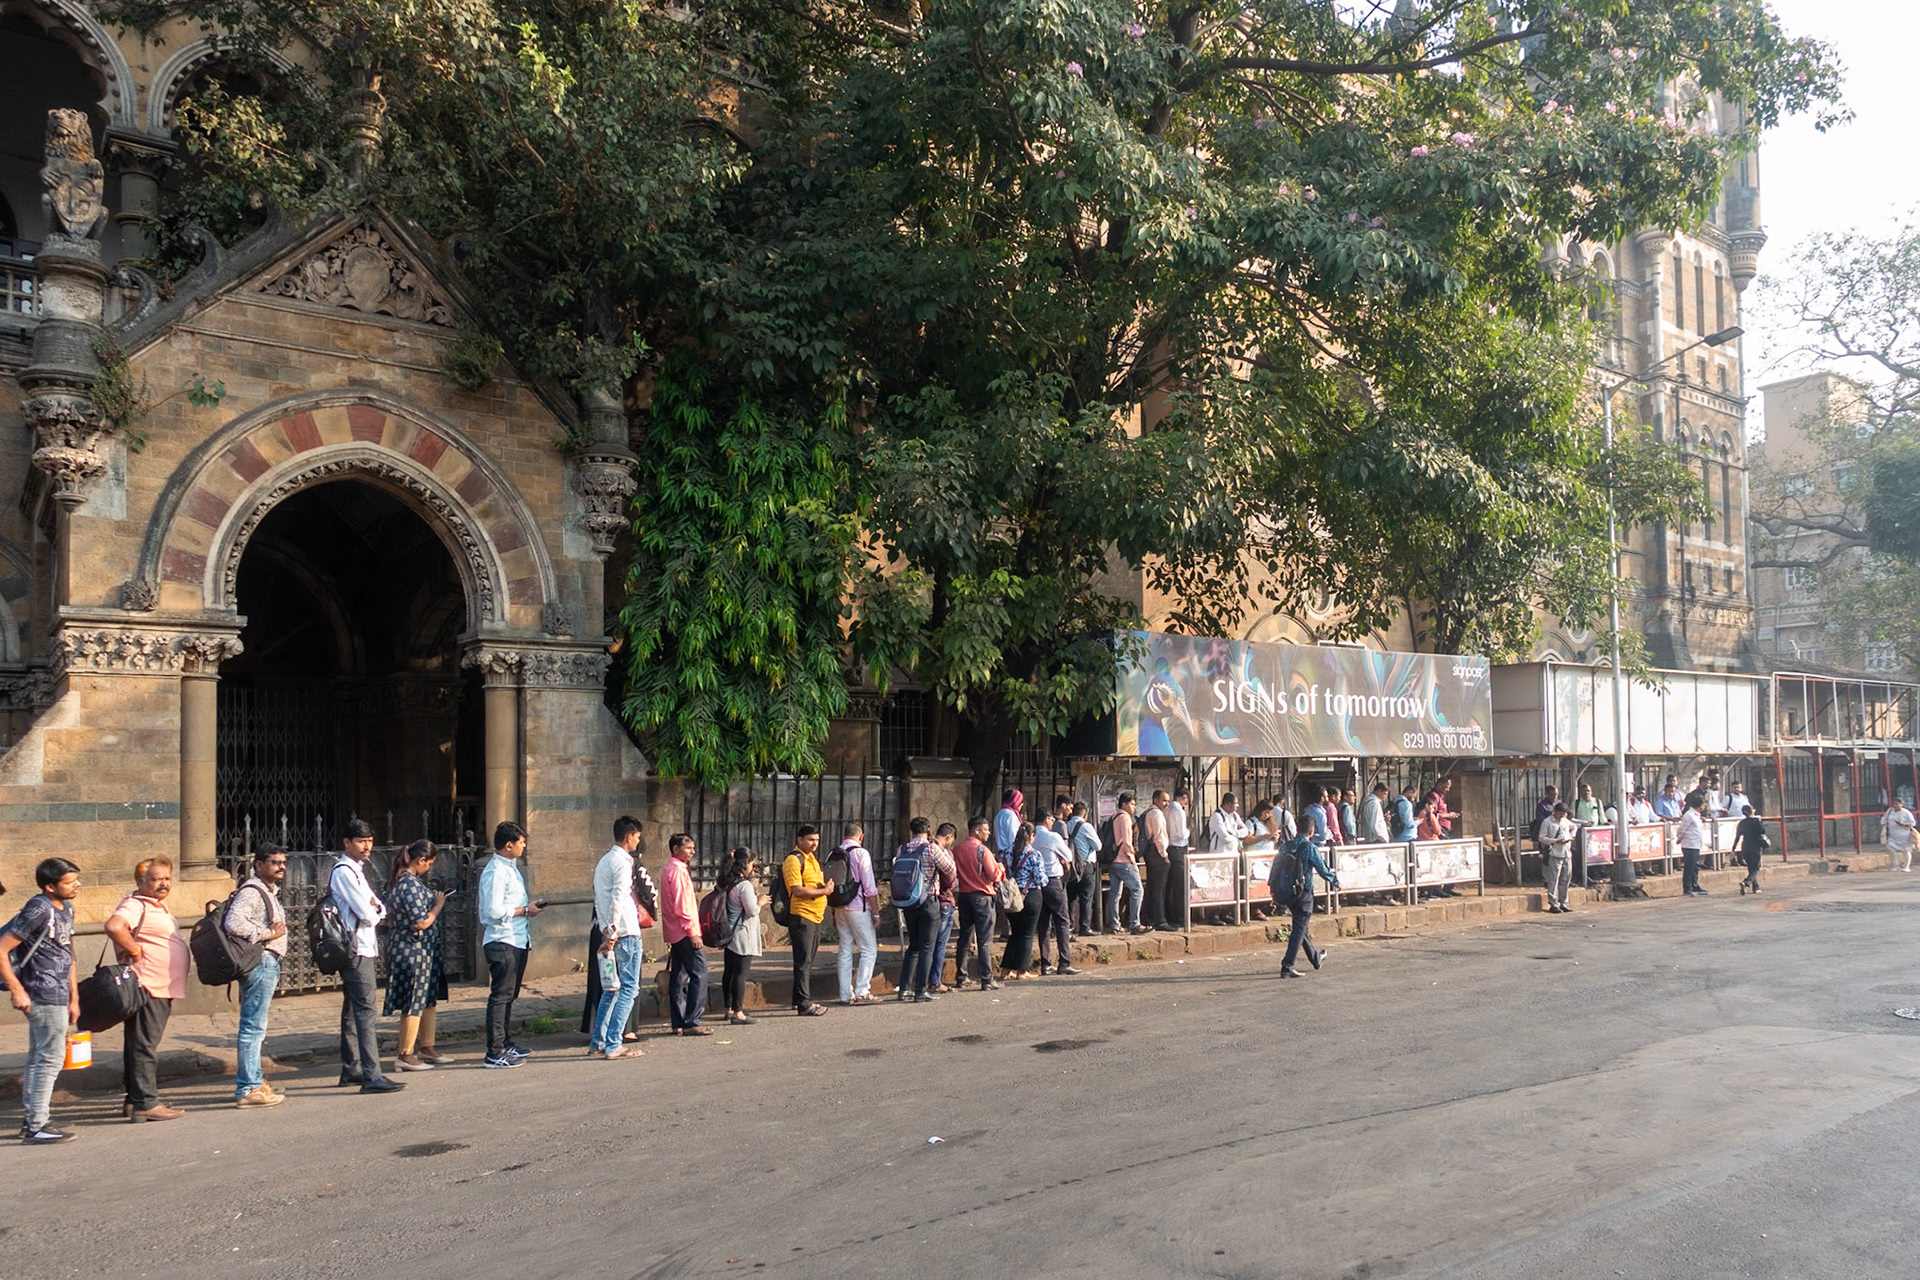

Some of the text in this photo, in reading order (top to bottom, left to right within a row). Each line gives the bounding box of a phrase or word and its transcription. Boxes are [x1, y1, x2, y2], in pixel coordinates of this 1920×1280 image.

[1452, 664, 1483, 679] signpost
[1213, 680, 1427, 718] SIGNs of tomorrow
[1403, 732, 1424, 749] 829
[1427, 734, 1441, 749] 119
[1443, 734, 1457, 749] 00
